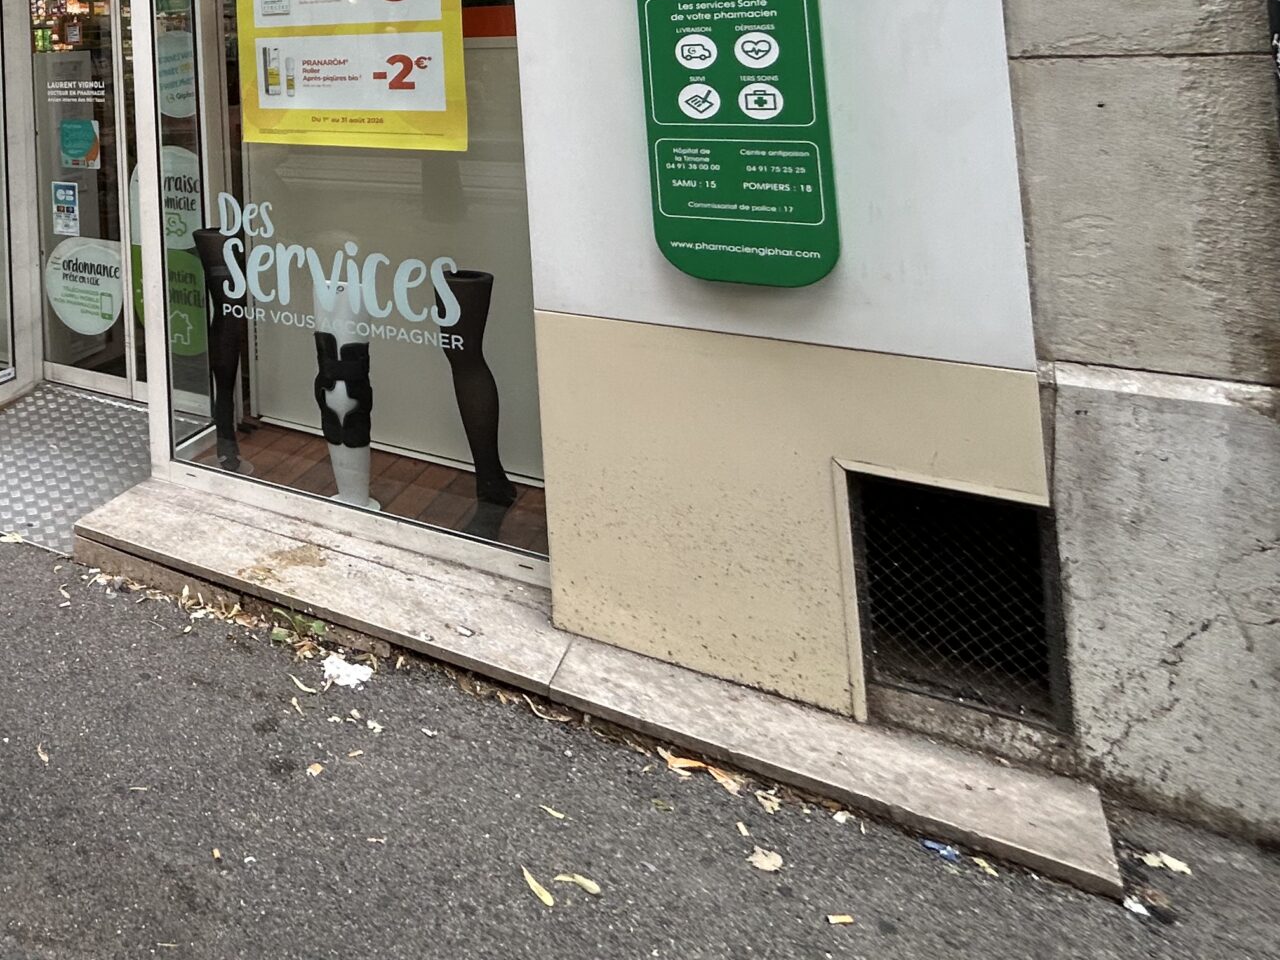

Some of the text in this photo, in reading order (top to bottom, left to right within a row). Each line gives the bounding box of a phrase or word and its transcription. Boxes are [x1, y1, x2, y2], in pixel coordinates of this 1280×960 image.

[678, 2, 693, 11] Les
[695, 1, 735, 10] services
[670, 9, 778, 21] de votre pharmacien
[47, 81, 105, 89] LAURENT VIGNOLI
[672, 179, 717, 189] SAMU 15
[743, 181, 813, 193] POMPIERS 18
[739, 203, 750, 211] de
[751, 204, 777, 213] police
[783, 205, 794, 213] 17
[218, 191, 275, 238] Des
[670, 240, 821, 259] www.pharmaciengiphar.com
[62, 257, 120, 280] ordonnance
[223, 303, 465, 351] POUR VOUS ACCOMPAGNER
